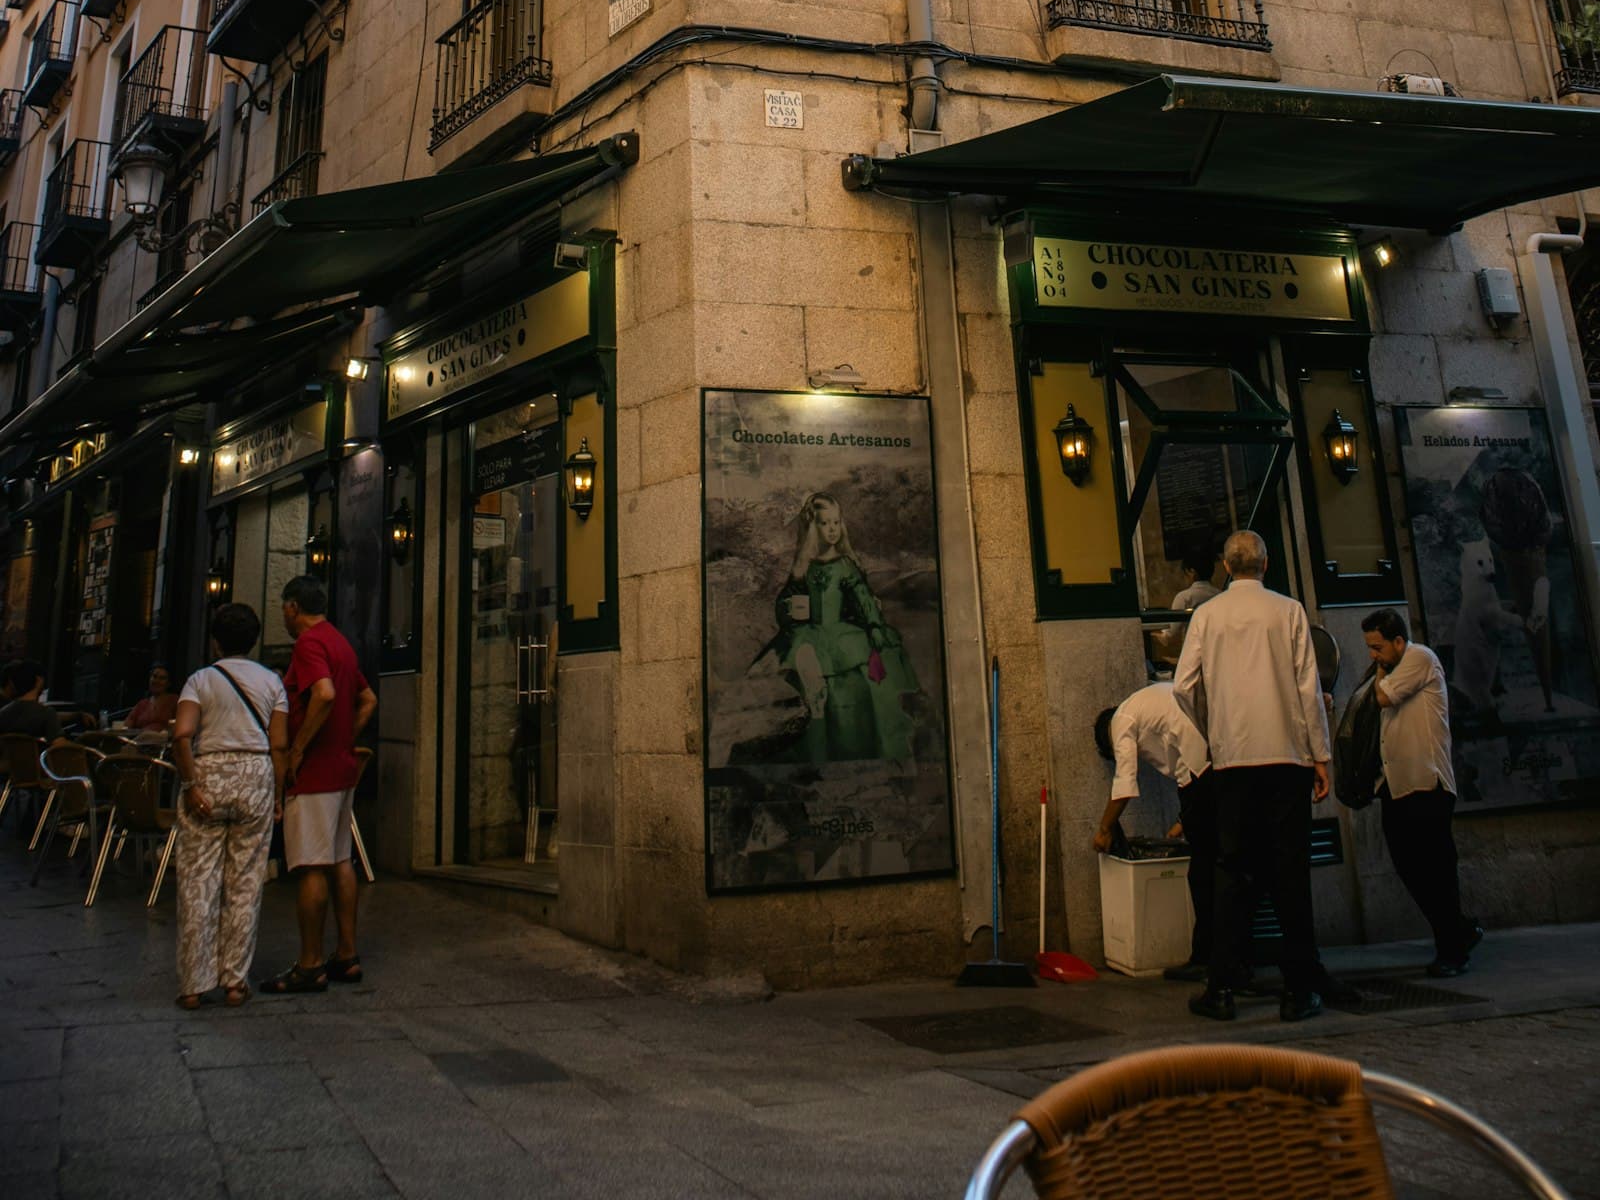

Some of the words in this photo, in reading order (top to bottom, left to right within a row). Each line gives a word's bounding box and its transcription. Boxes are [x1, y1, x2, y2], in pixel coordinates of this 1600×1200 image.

[770, 106, 797, 117] CASA
[783, 117, 797, 127] 22
[1087, 243, 1299, 276] CHOCOLATERIA
[1124, 272, 1182, 296] SAN
[1191, 277, 1272, 300] GINES
[427, 302, 527, 364] CHOCOLATERIA
[440, 355, 465, 382] SAN
[470, 334, 511, 369] GINES
[732, 429, 824, 446] Chocolates
[828, 432, 912, 448] Artesanos
[1423, 435, 1470, 448] Helados
[1473, 435, 1531, 449] Artesanos
